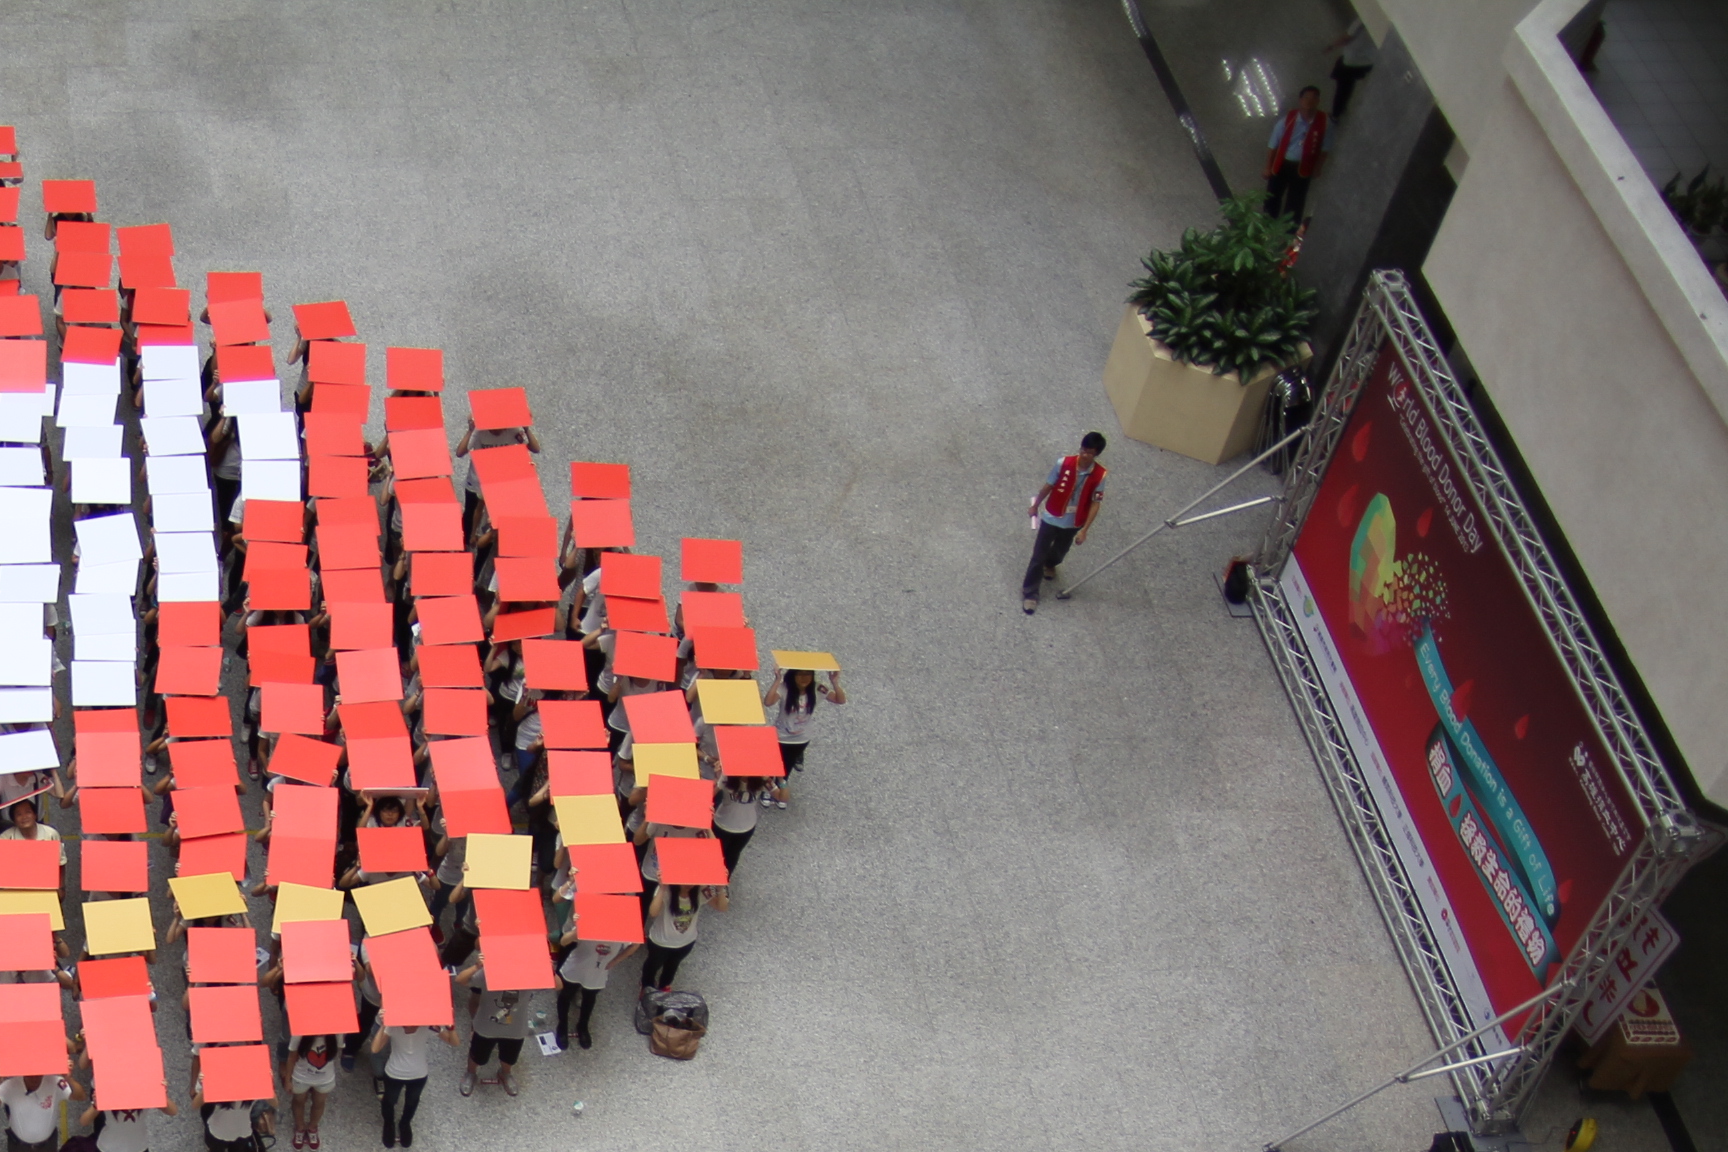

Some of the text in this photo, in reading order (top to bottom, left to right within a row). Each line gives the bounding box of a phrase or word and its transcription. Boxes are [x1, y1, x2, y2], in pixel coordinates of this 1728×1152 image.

[1415, 417, 1443, 470] Blood
[1438, 463, 1467, 517] Donor
[1463, 512, 1483, 553] Day
[1421, 643, 1556, 917] Every Blood Donation is a Gift of Life
[1429, 741, 1547, 967] 捐血 拯救生命的禮物
